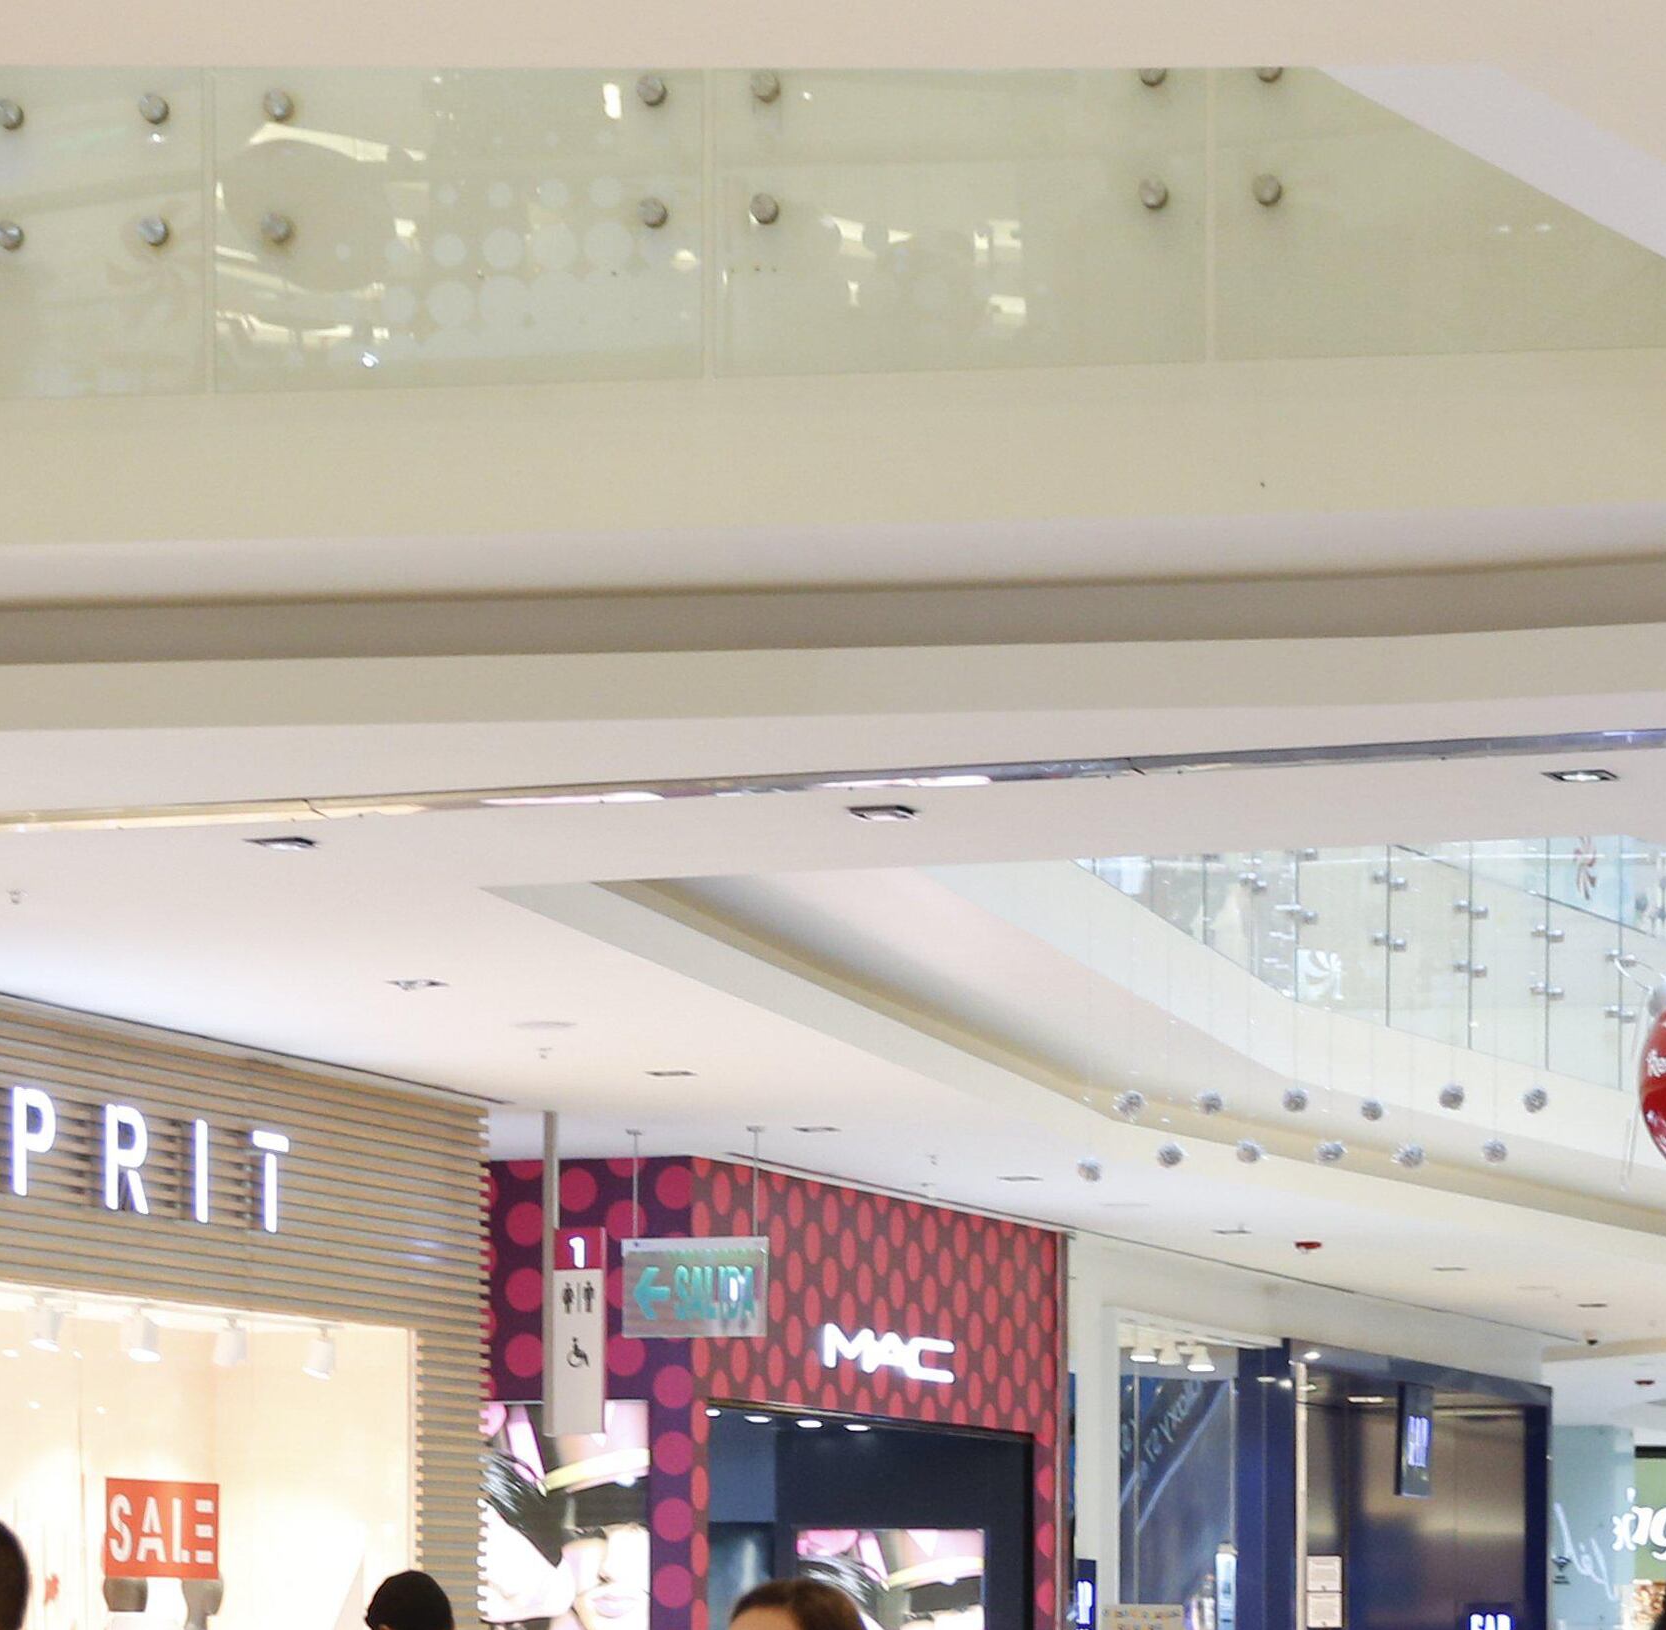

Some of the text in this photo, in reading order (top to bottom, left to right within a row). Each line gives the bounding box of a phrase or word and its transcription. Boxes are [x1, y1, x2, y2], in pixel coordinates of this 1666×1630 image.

[568, 1236, 586, 1269] 1
[673, 1264, 755, 1320] SALIDA
[822, 1322, 955, 1384] MAC
[108, 1492, 215, 1565] SALE
